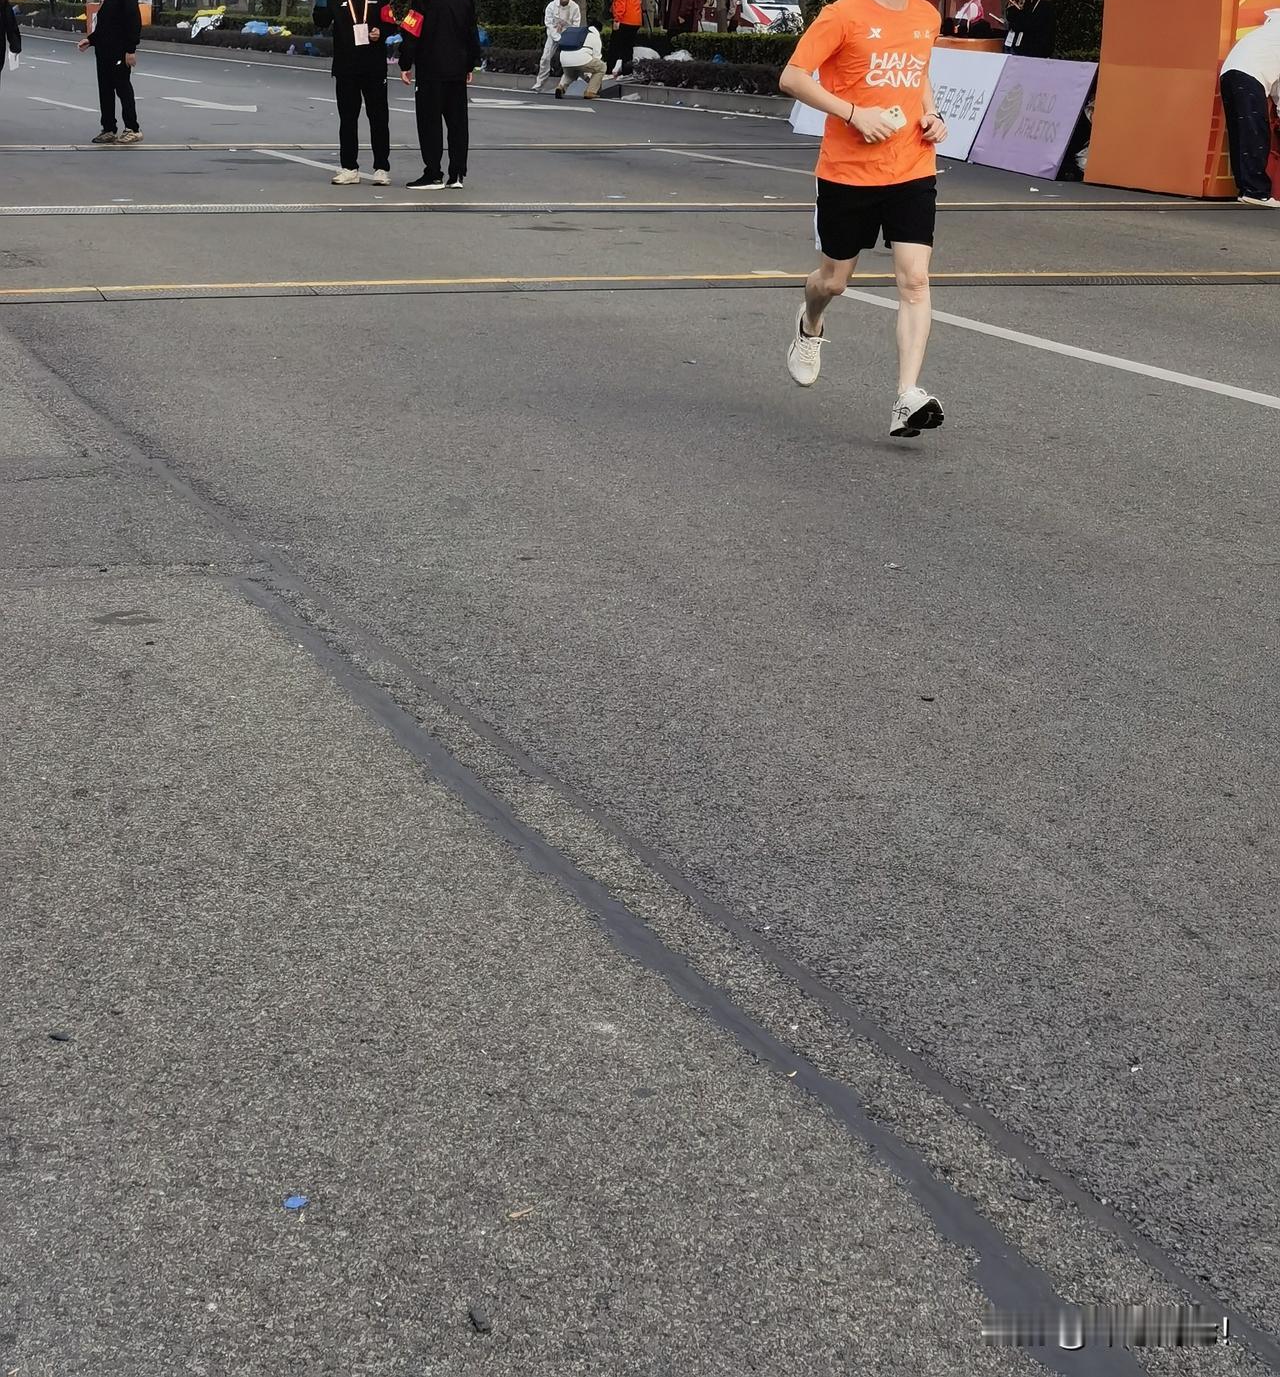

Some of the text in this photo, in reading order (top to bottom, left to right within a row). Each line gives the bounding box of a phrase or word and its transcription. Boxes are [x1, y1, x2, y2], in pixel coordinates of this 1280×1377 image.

[865, 69, 922, 88] CANG
[934, 85, 985, 121] 国田径协会
